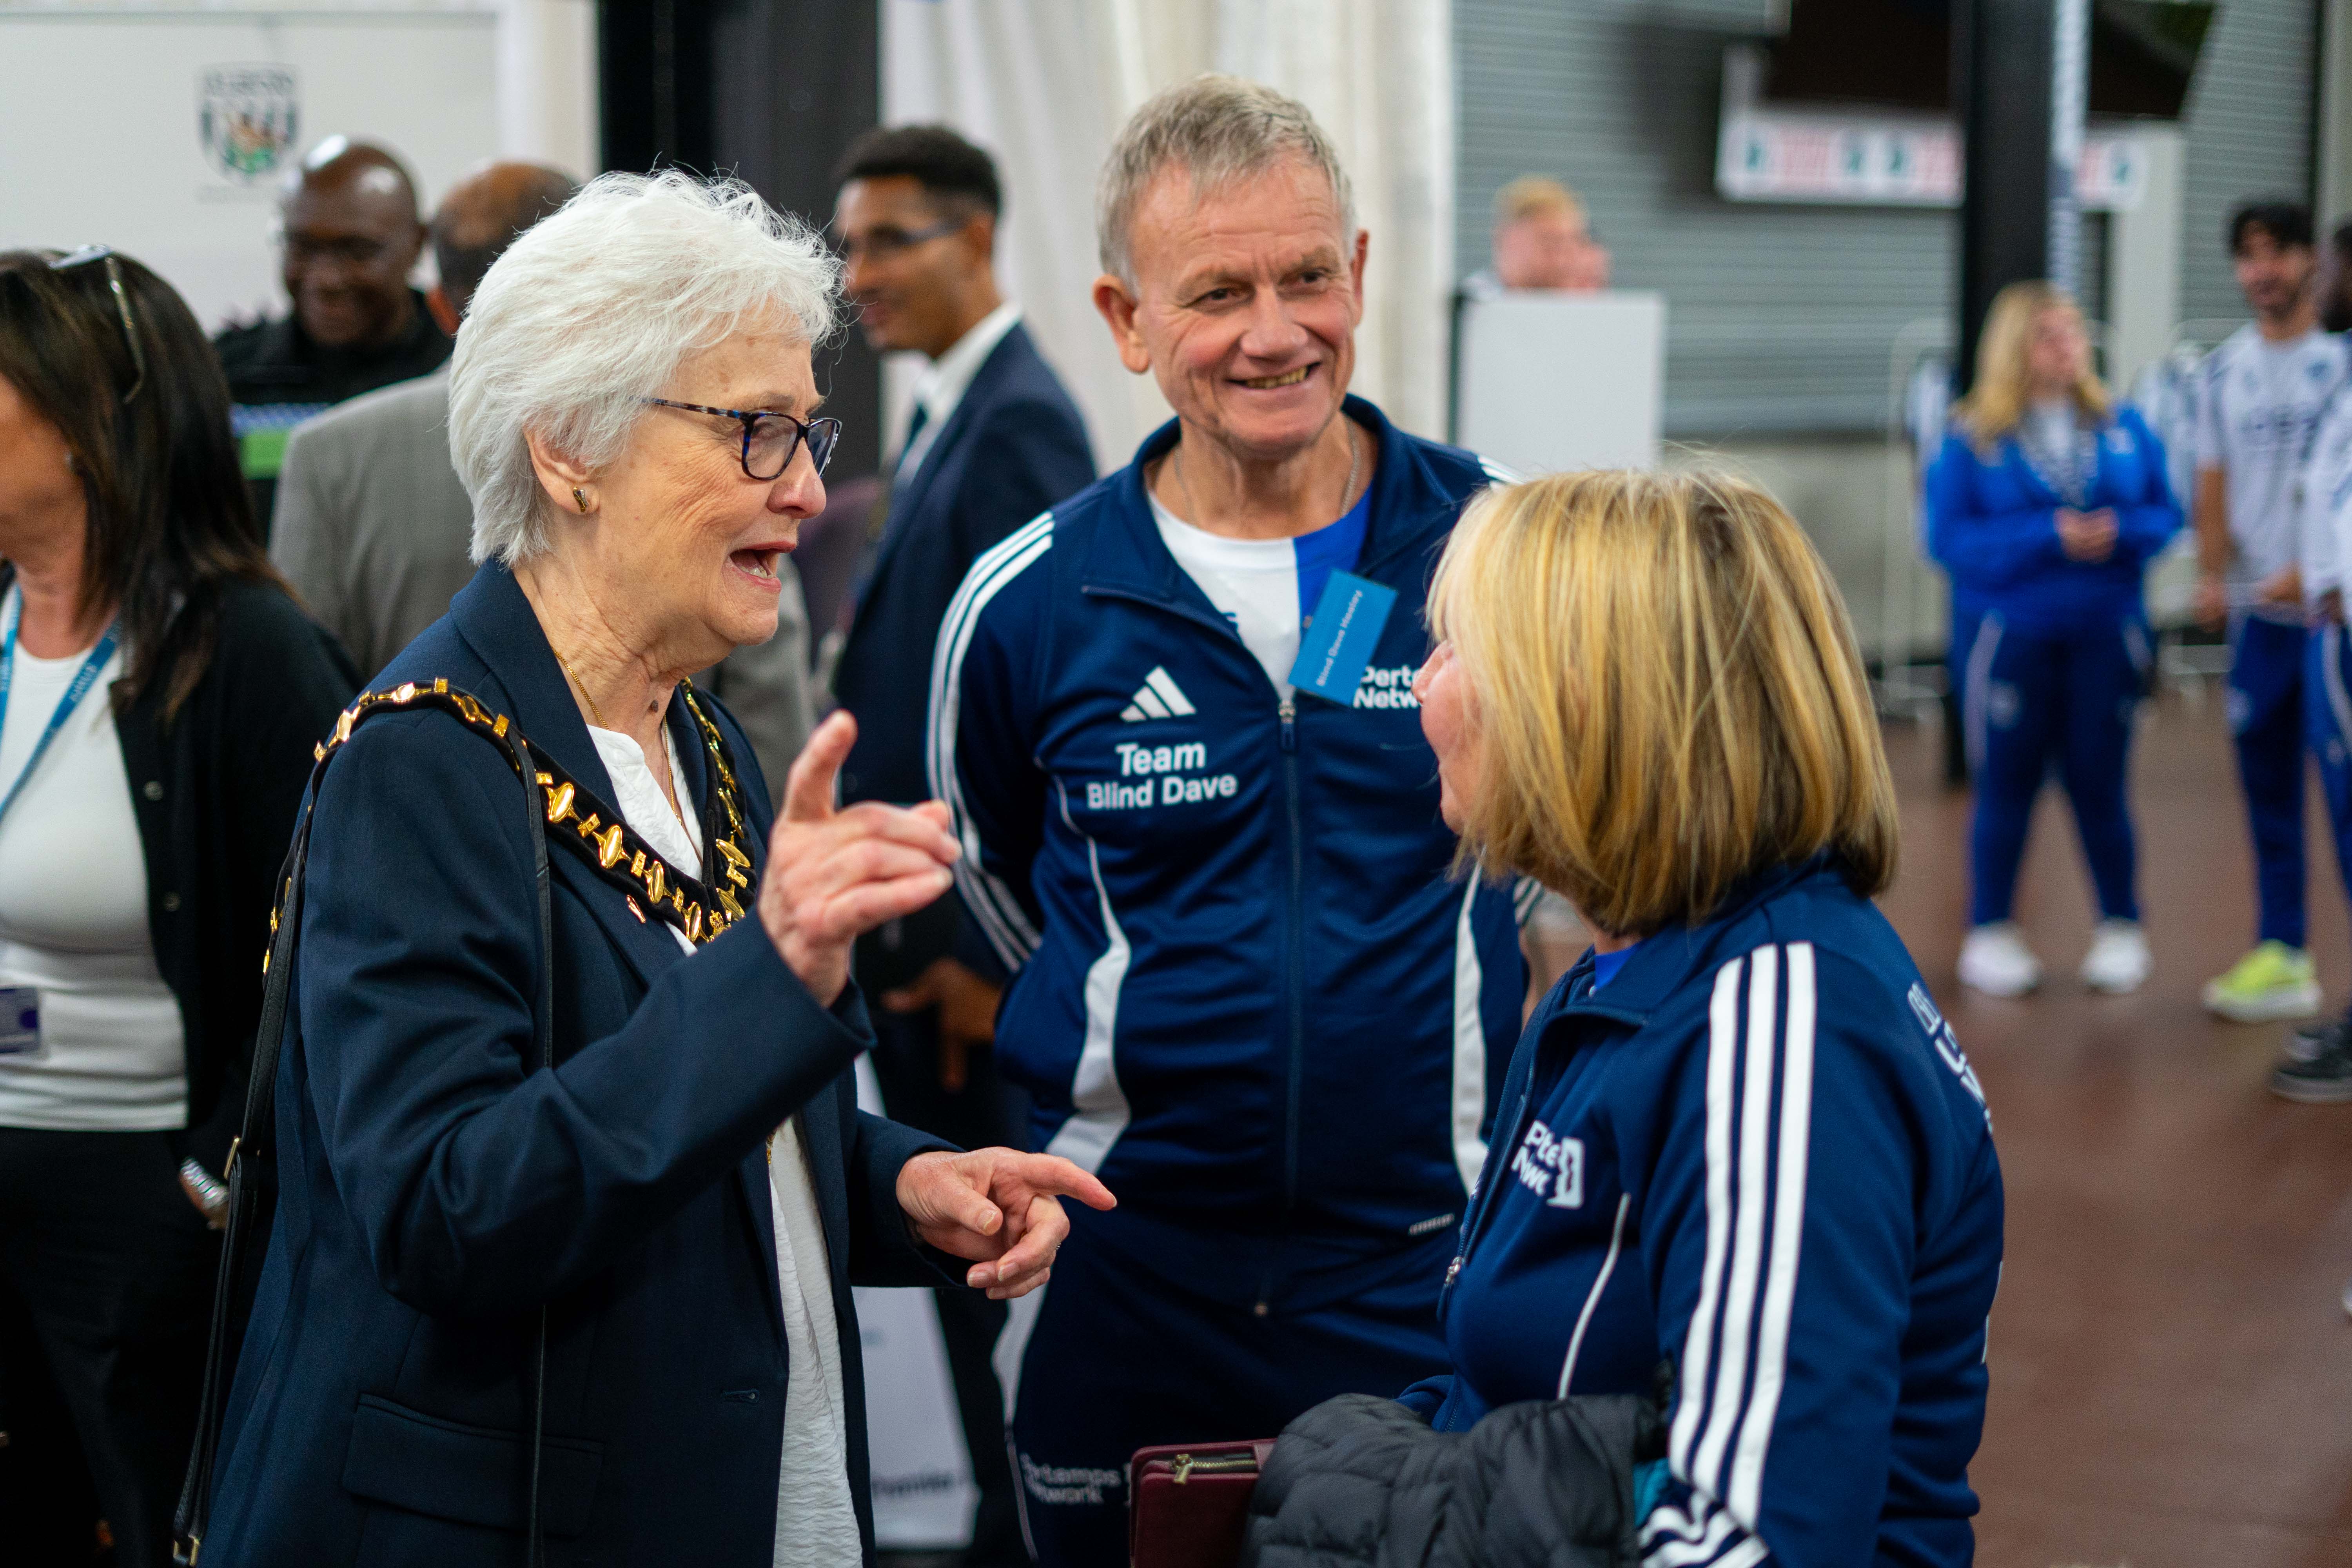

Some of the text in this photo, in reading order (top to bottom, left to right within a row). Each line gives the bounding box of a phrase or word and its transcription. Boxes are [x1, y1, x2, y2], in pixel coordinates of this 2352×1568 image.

[1116, 742, 1206, 777] Team
[1087, 775, 1238, 810] Blind Dave
